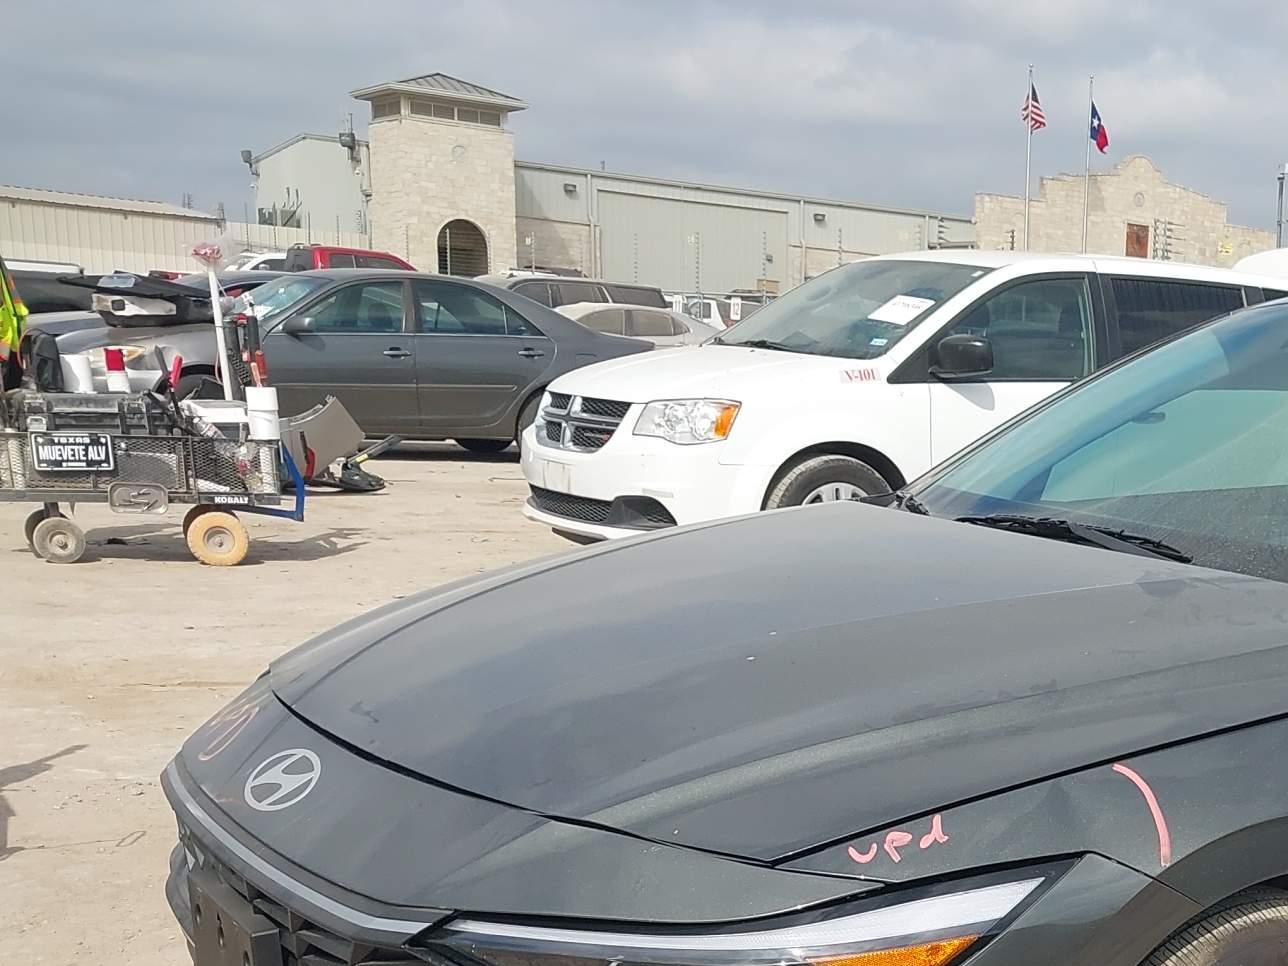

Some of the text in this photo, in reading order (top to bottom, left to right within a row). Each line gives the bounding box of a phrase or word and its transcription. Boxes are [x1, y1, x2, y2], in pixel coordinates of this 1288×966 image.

[52, 436, 91, 444] TEXAS
[38, 445, 106, 461] MUEVETE ALV
[214, 496, 249, 504] KOBALT
